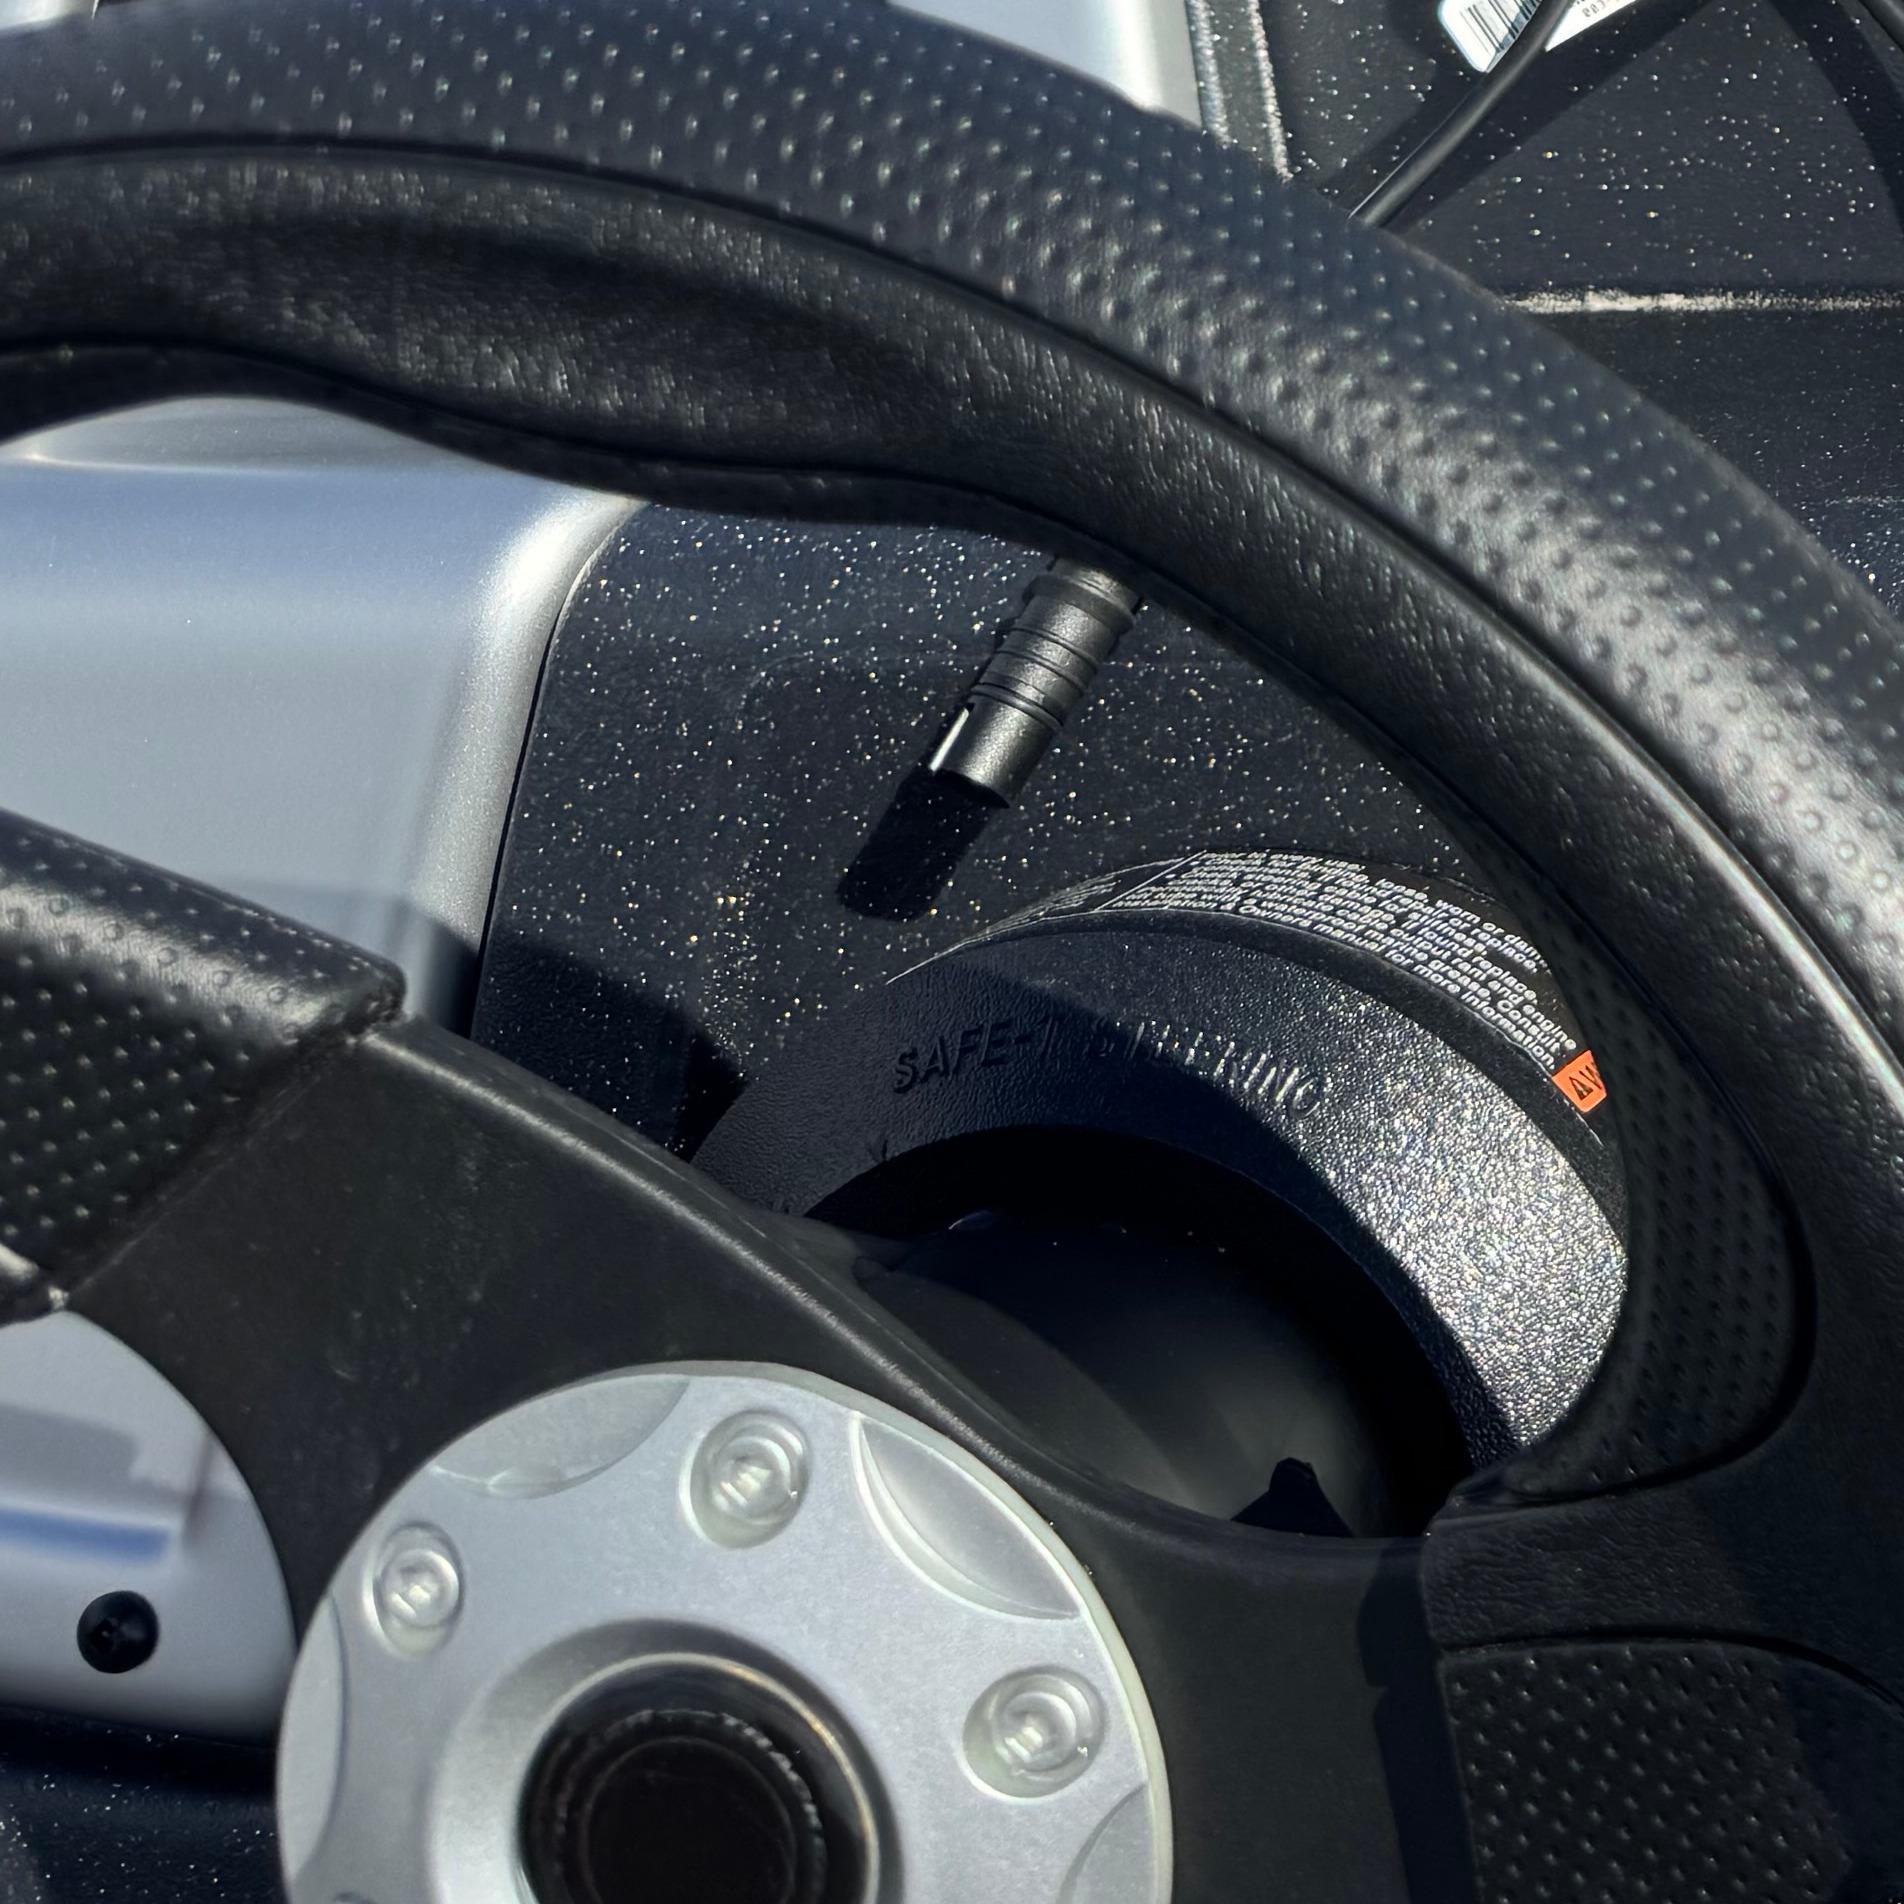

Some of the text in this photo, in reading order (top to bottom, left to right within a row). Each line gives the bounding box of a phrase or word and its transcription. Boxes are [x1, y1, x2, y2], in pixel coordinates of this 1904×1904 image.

[1264, 883, 1318, 897] other
[1417, 927, 1475, 958] found
[1323, 885, 1377, 904] cable
[1378, 898, 1409, 914] for
[1392, 894, 1449, 920] repair
[1448, 917, 1472, 930] or
[1435, 899, 1481, 925] worn
[1482, 922, 1505, 936] or
[1238, 905, 1312, 927] Owners
[1312, 923, 1389, 953] manual
[1384, 949, 1415, 966] for
[1412, 964, 1462, 994] more
[1260, 900, 1368, 933] waterproof
[1363, 930, 1429, 961] marine
[1496, 999, 1562, 1054] Consult
[1336, 908, 1388, 931] cable
[1389, 928, 1452, 960] output
[1451, 957, 1488, 982] ram
[1487, 980, 1525, 1005] and
[1522, 1003, 1577, 1051] engine
